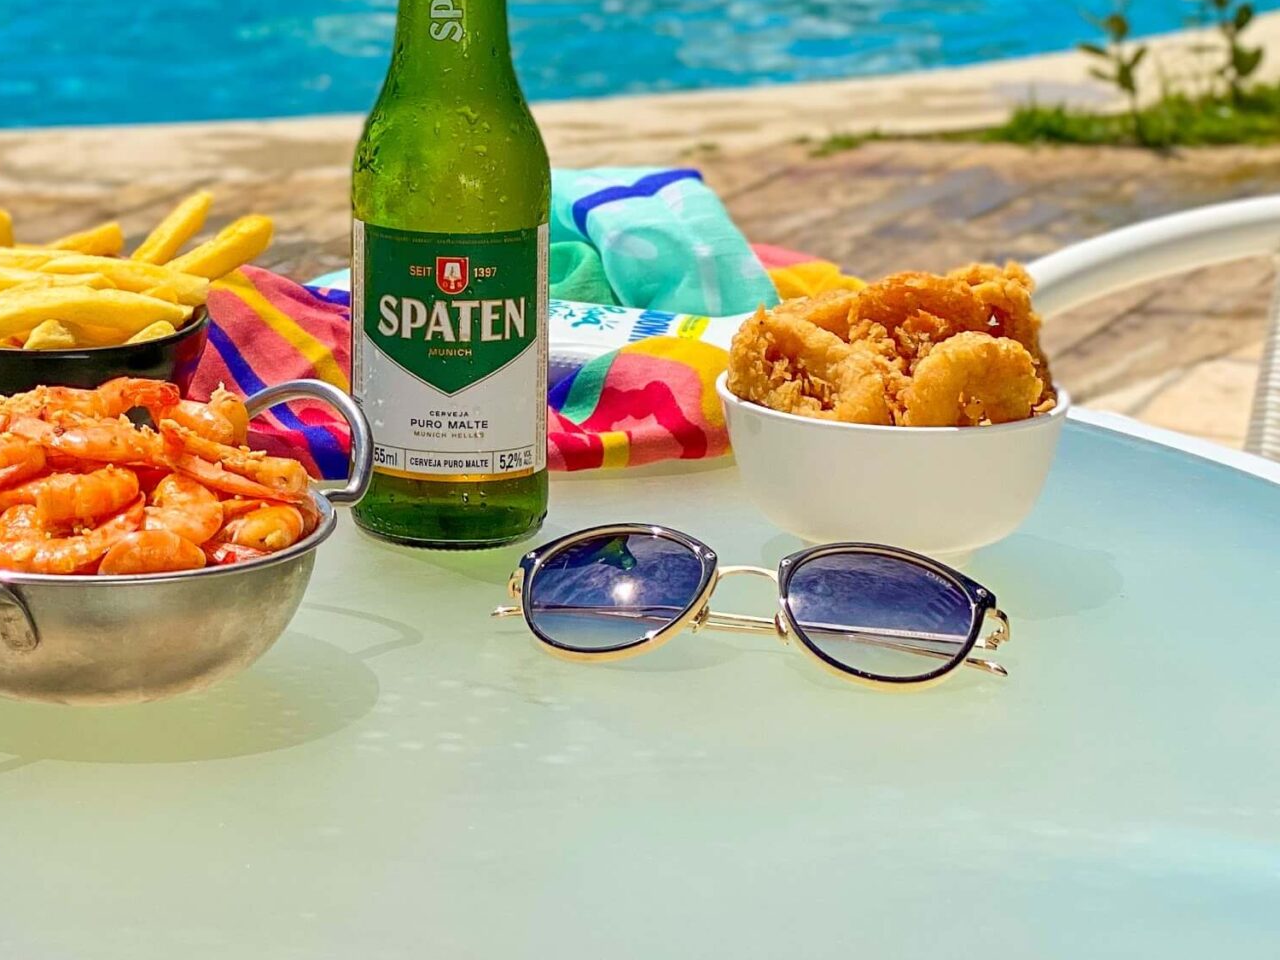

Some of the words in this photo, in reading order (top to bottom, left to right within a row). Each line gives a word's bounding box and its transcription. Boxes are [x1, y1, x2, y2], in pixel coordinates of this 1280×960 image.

[409, 265, 432, 277] SEIT
[473, 266, 497, 278] 1397
[377, 293, 526, 342] SPATEN
[428, 348, 473, 357] MUNICH
[410, 418, 442, 429] PURO
[448, 420, 489, 429] MALTE
[373, 446, 398, 467] 55ml
[410, 457, 442, 467] CERVEJA
[443, 459, 464, 468] PURO
[465, 459, 489, 468] MALTE
[925, 570, 953, 590] Dior
